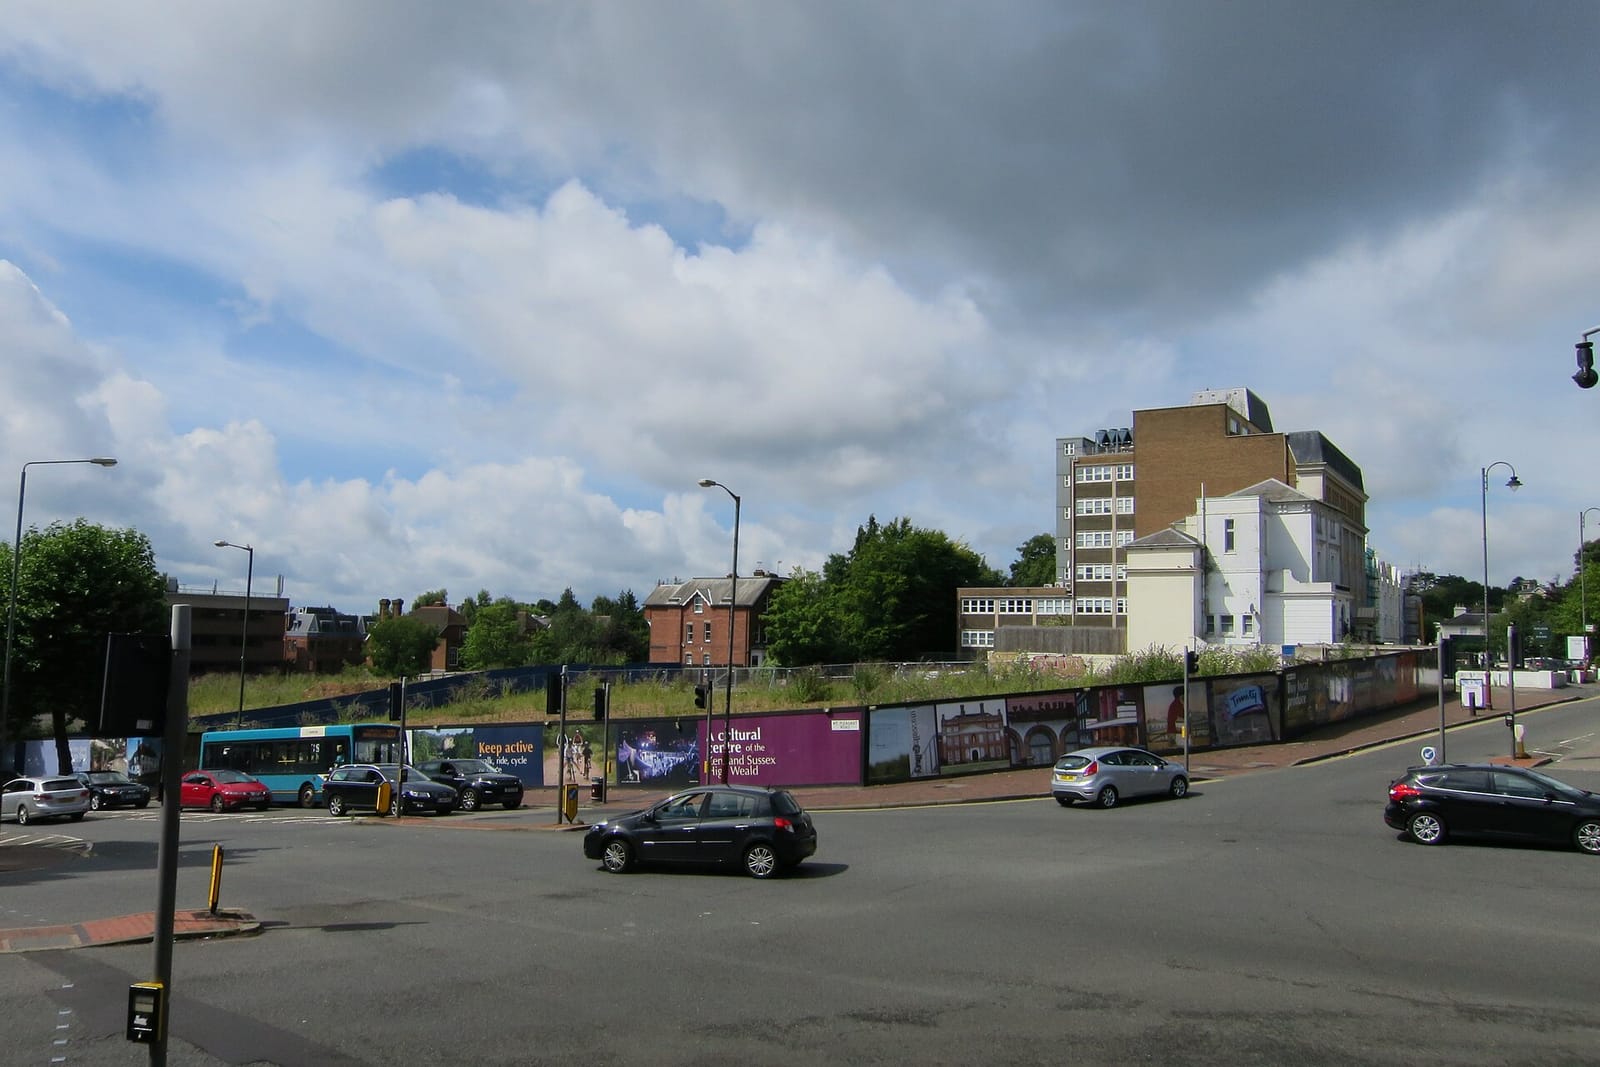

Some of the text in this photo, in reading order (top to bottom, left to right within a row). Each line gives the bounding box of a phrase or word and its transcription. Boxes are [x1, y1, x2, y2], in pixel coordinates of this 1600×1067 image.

[718, 727, 760, 741] cltural
[478, 740, 533, 757] Keep active
[754, 743, 765, 751] the
[510, 756, 527, 767] cycle
[729, 755, 745, 765] and
[747, 754, 776, 765] Sussex
[711, 766, 759, 779] Hig Weald
